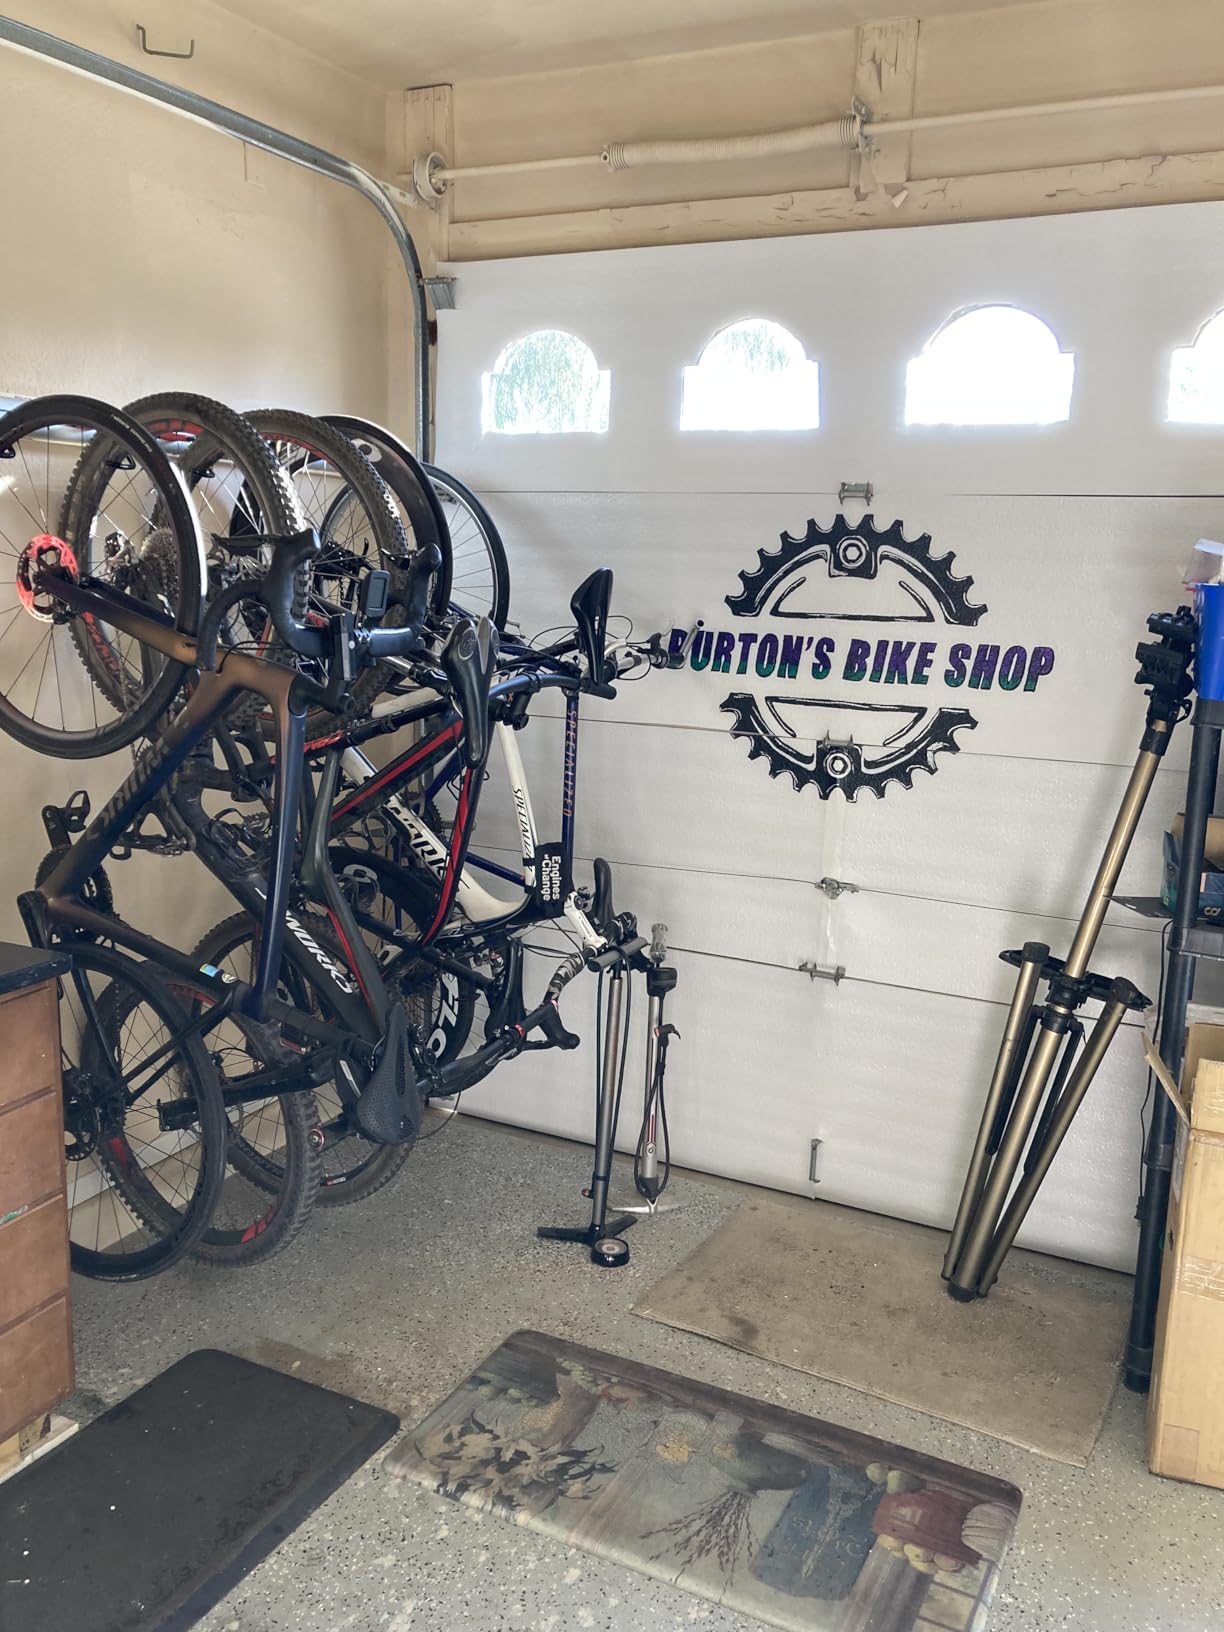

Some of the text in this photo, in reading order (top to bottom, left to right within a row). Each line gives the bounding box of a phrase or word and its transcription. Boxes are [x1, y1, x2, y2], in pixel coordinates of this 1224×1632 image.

[843, 638, 937, 685] BIKE
[944, 643, 1056, 692] SHOP
[540, 859, 552, 902] Change
[550, 856, 562, 900] Engines
